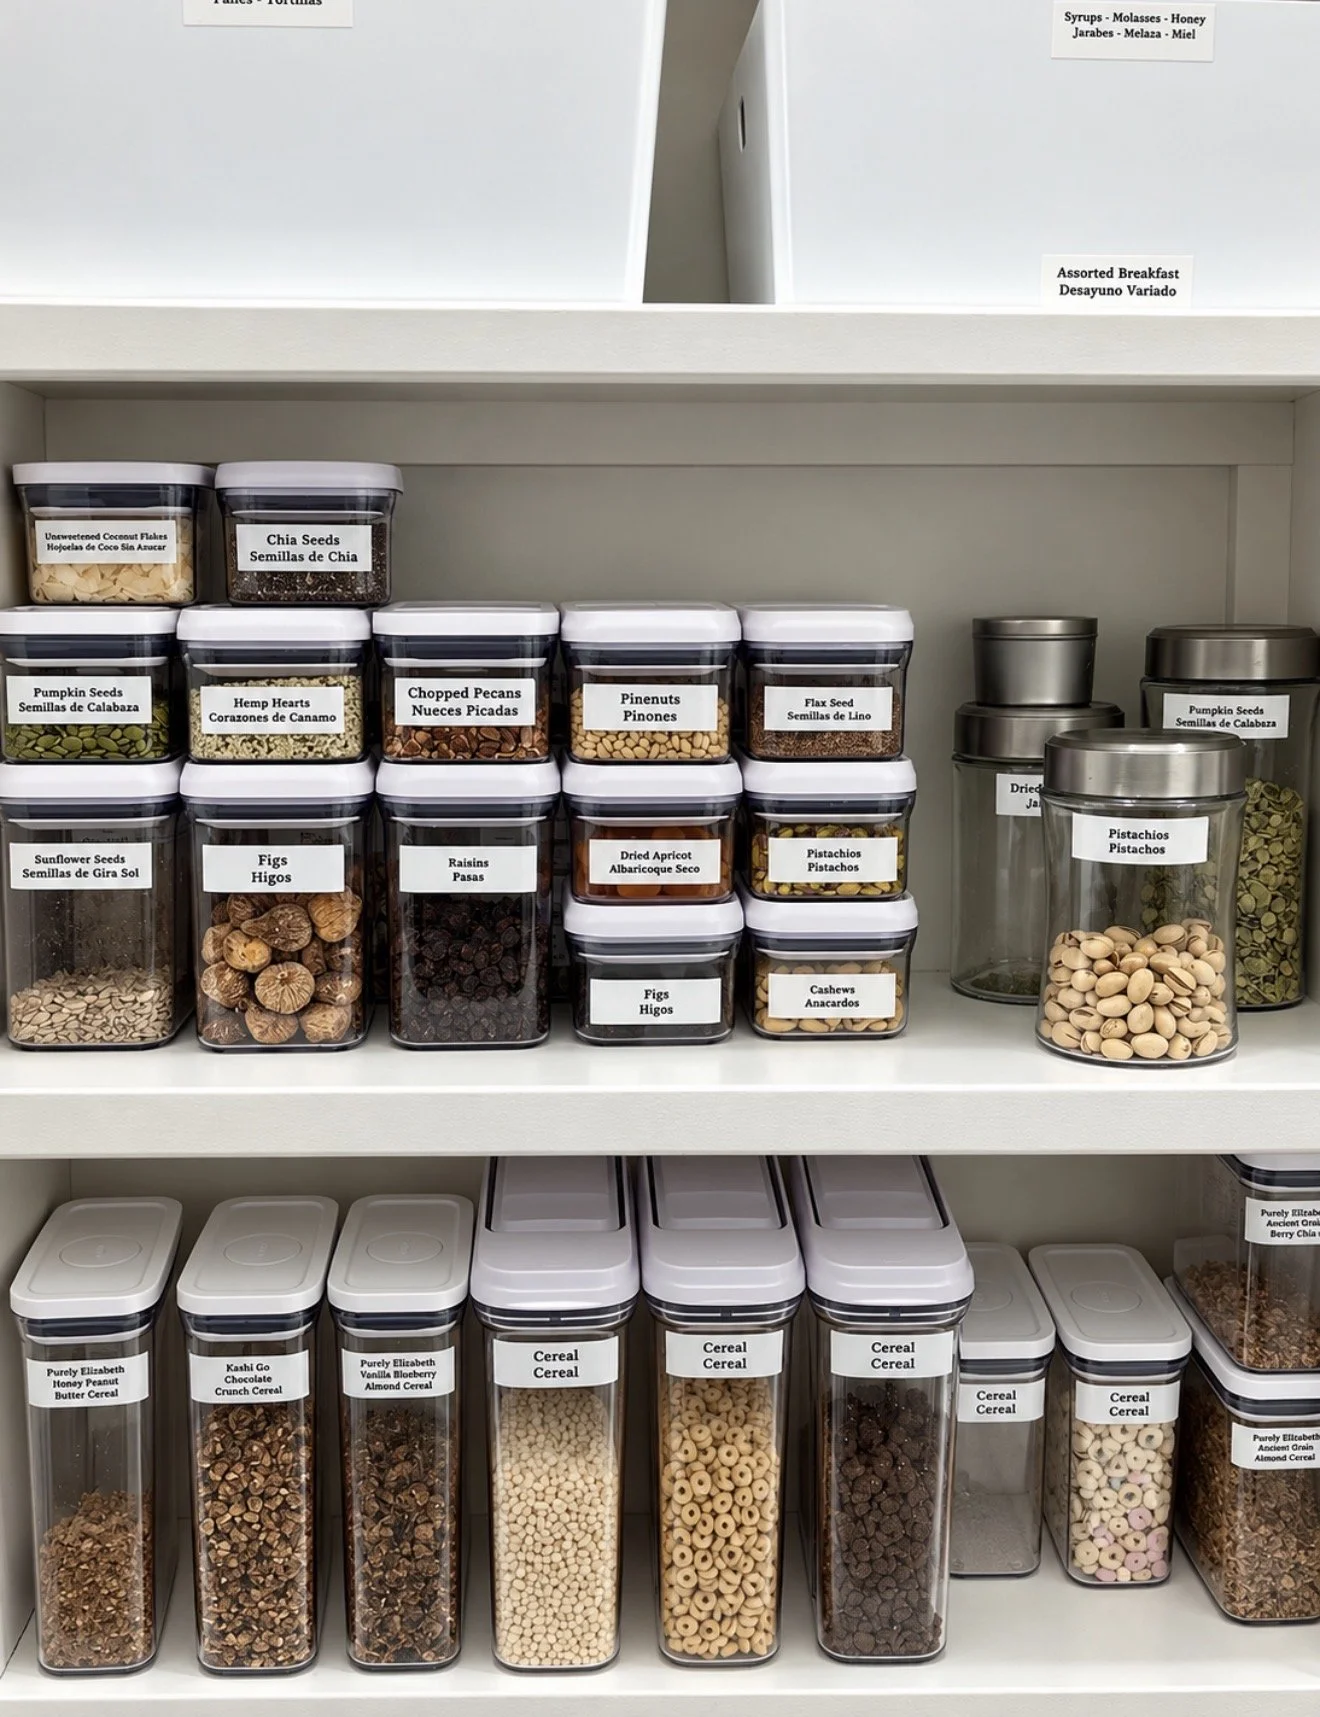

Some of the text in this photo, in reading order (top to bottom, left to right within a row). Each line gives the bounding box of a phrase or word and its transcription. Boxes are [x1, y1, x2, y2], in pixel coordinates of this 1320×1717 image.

[1064, 11, 1103, 26] Syrups
[1112, 12, 1162, 23] Molasses
[1072, 26, 1114, 39] Jarabes
[1123, 28, 1162, 39] Melaza
[1171, 28, 1196, 40] Miel
[1056, 266, 1180, 279] Assorted Breakfast
[1059, 284, 1177, 299] Desayuno Variado
[44, 532, 101, 541] Unsweetened
[102, 532, 139, 541] Coconut
[266, 533, 340, 546] Chia Seeds
[85, 543, 96, 551] de
[97, 542, 120, 552] Coco
[120, 542, 135, 551] Sin
[136, 543, 167, 551] Azucar
[249, 549, 359, 563] Semillas de Chia
[33, 686, 123, 701] Pumpkin Seeds
[407, 686, 522, 702] Chopped Pecans
[620, 692, 681, 705] Pinenuts
[18, 701, 140, 713] Semillas de Calabaza
[233, 697, 311, 711] Hemp Hearts
[804, 698, 854, 708] Flax Seed
[411, 704, 519, 717] Nueces Picadas
[623, 709, 677, 722] Pinones
[787, 710, 872, 721] Semillas de Lino
[1188, 705, 1265, 718] Pumpkin Seeds
[208, 711, 337, 723] Corazones de Canamo
[1175, 717, 1277, 728] Semillas de Calabaza
[1026, 799, 1041, 809] Ja
[1108, 828, 1170, 841] Pistachios
[806, 848, 862, 859] Pistachios
[1108, 842, 1166, 855] Pistachos
[34, 853, 126, 865] Sunflower Seeds
[257, 853, 288, 870] Figs
[448, 857, 489, 868] Raisins
[620, 850, 692, 863] Dried Apricot
[22, 867, 140, 879] Semillas de Gira Sol
[609, 864, 700, 877] Albaricoque Seco
[807, 862, 860, 872] Pistachos
[251, 871, 292, 887] Higos
[452, 871, 485, 882] Pasas
[643, 988, 670, 1003] Figs
[809, 984, 856, 995] Cashews
[804, 997, 860, 1008] Anacardos
[639, 1003, 674, 1018] Higos
[1260, 1208, 1290, 1218] Purely
[1265, 1217, 1300, 1228] Ancient
[1270, 1229, 1295, 1240] Berry
[1296, 1229, 1316, 1238] Chia
[702, 1340, 747, 1354] Cereal
[871, 1341, 915, 1354] Cereal
[533, 1349, 579, 1362] Cereal
[226, 1362, 271, 1373] Kashi Go
[360, 1358, 391, 1370] Purely
[702, 1356, 747, 1369] Cereal
[870, 1356, 916, 1369] Cereal
[46, 1367, 79, 1378] Purely
[533, 1366, 580, 1378] Cereal
[86, 1378, 119, 1388] Peanut
[224, 1374, 273, 1385] Chocolate
[364, 1380, 433, 1391] Almond Cereal
[54, 1388, 119, 1400] Butter Cereal
[214, 1385, 283, 1396] Crunch Cereal
[976, 1389, 1017, 1401] Cereal
[1110, 1391, 1150, 1403] Cereal
[976, 1403, 1016, 1415] Cereal
[1109, 1405, 1149, 1417] Cereal
[1252, 1433, 1281, 1443] Purely
[1257, 1443, 1290, 1452] Ancient
[1254, 1453, 1316, 1463] Almond Cereal
